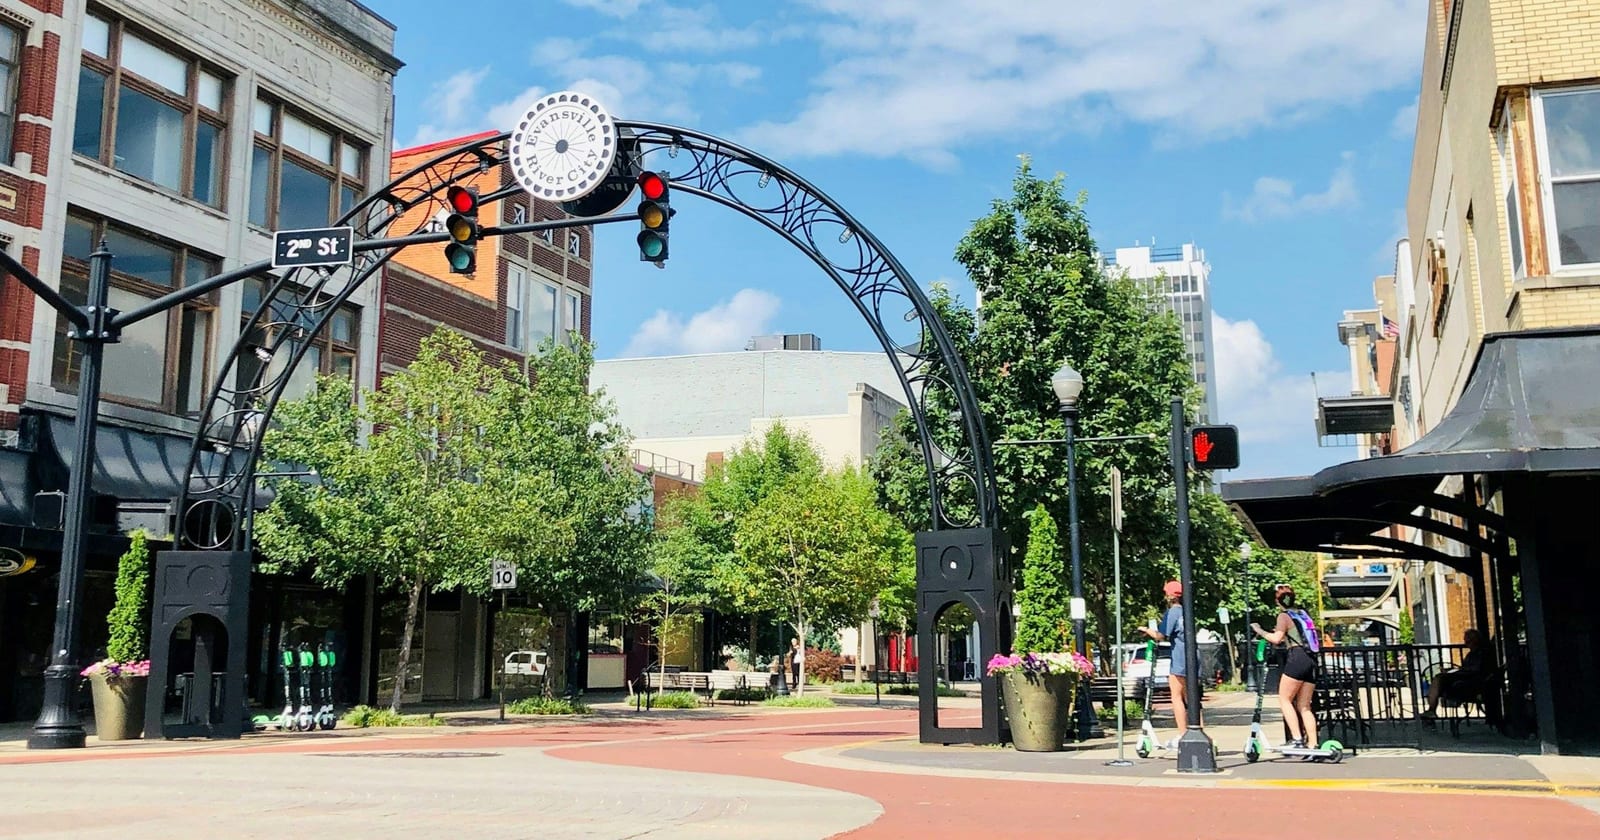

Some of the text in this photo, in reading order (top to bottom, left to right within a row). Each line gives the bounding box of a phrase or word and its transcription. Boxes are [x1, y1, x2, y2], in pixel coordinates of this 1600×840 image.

[525, 110, 597, 148] Evansville
[526, 149, 597, 186] River City
[317, 237, 340, 256] St
[496, 571, 512, 584] 10
